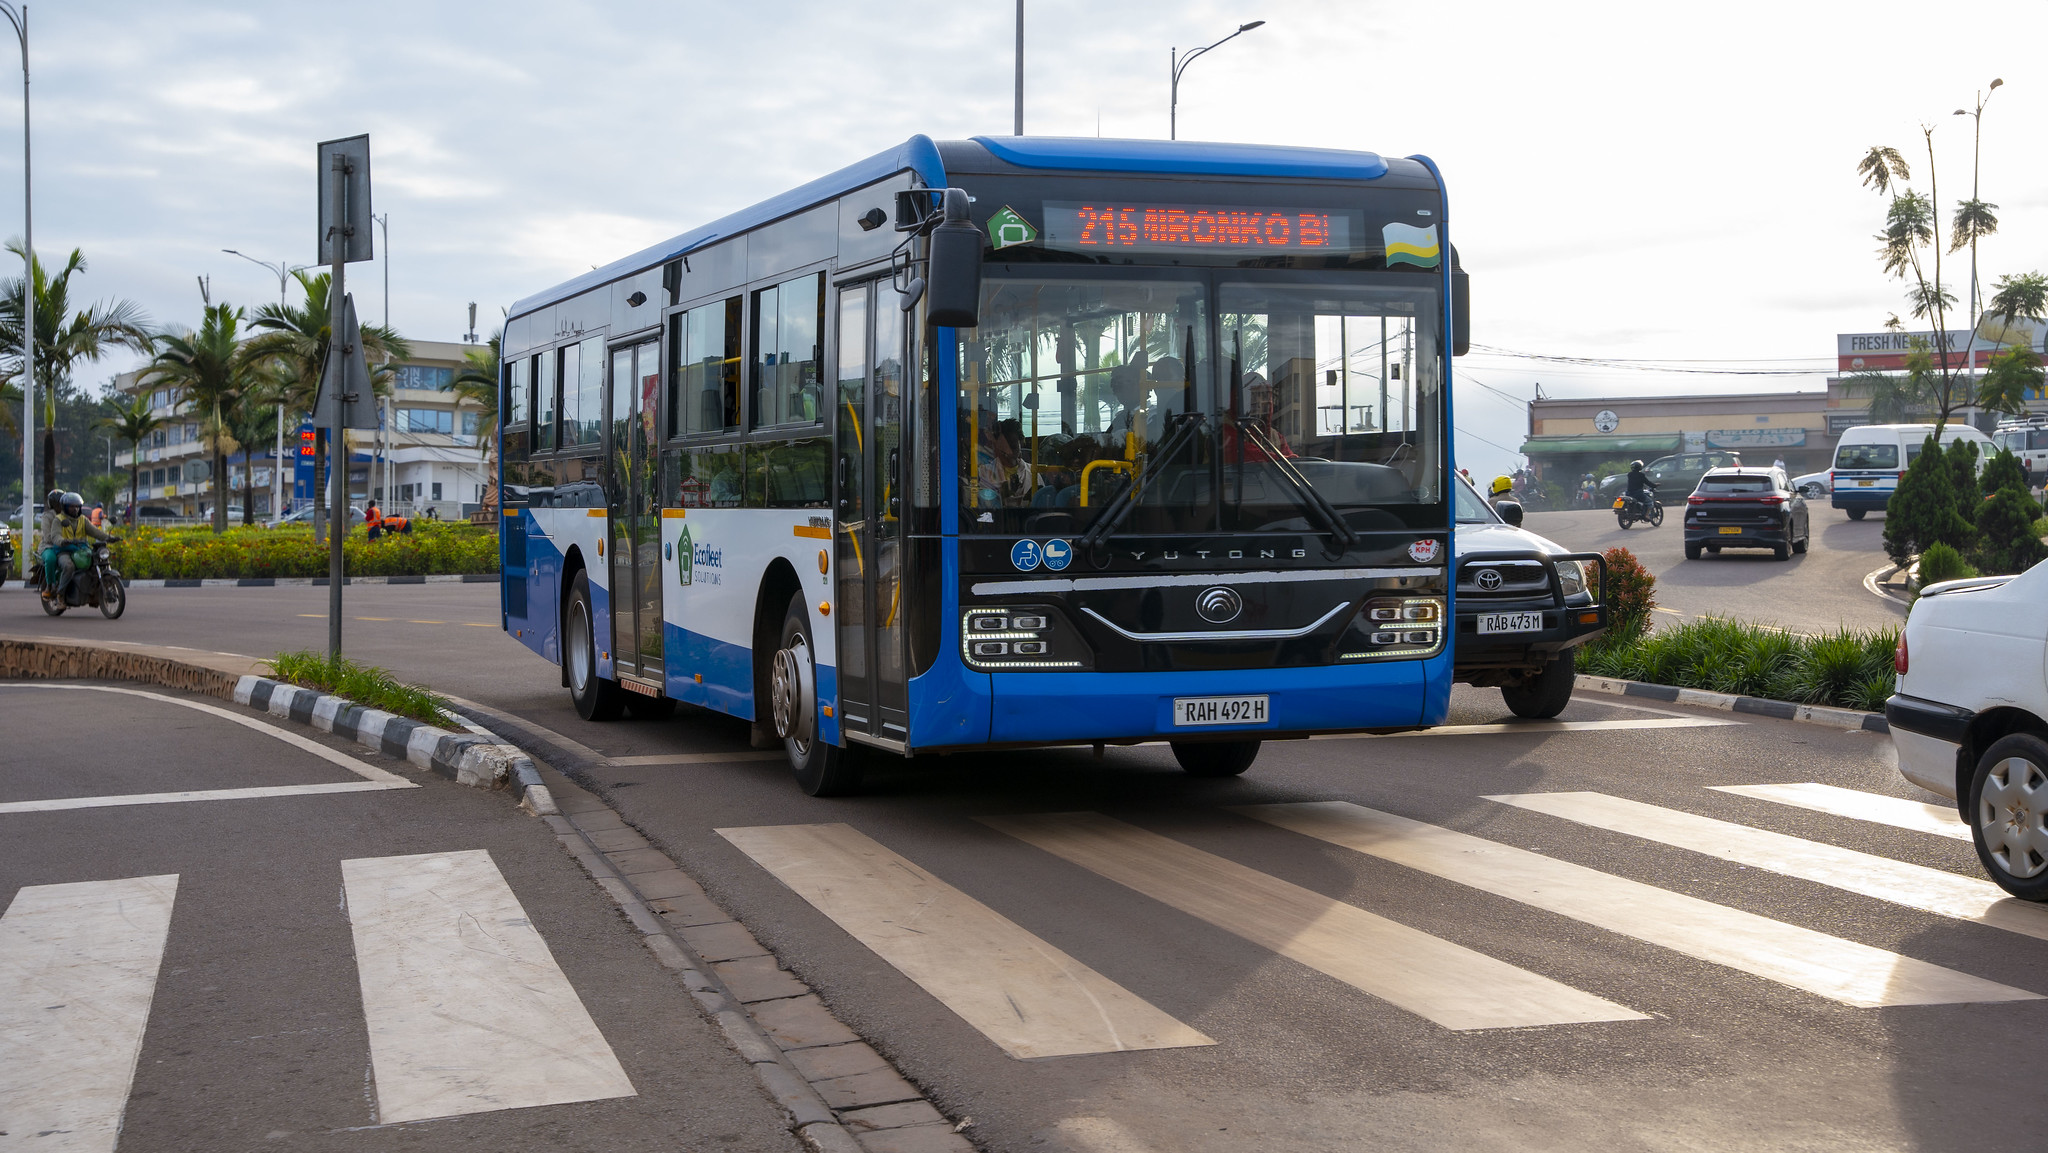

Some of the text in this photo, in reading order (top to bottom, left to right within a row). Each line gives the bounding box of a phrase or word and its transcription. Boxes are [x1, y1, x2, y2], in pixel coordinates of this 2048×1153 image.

[1078, 207, 1137, 245] 215
[1852, 336, 1889, 350] FRESH
[694, 543, 722, 568] Ecofleet
[1131, 549, 1306, 560] YUTONG
[695, 570, 721, 585] SOLUTIONS
[1487, 615, 1540, 631] RAB 473 M
[1186, 700, 1264, 721] RAH 492 H
